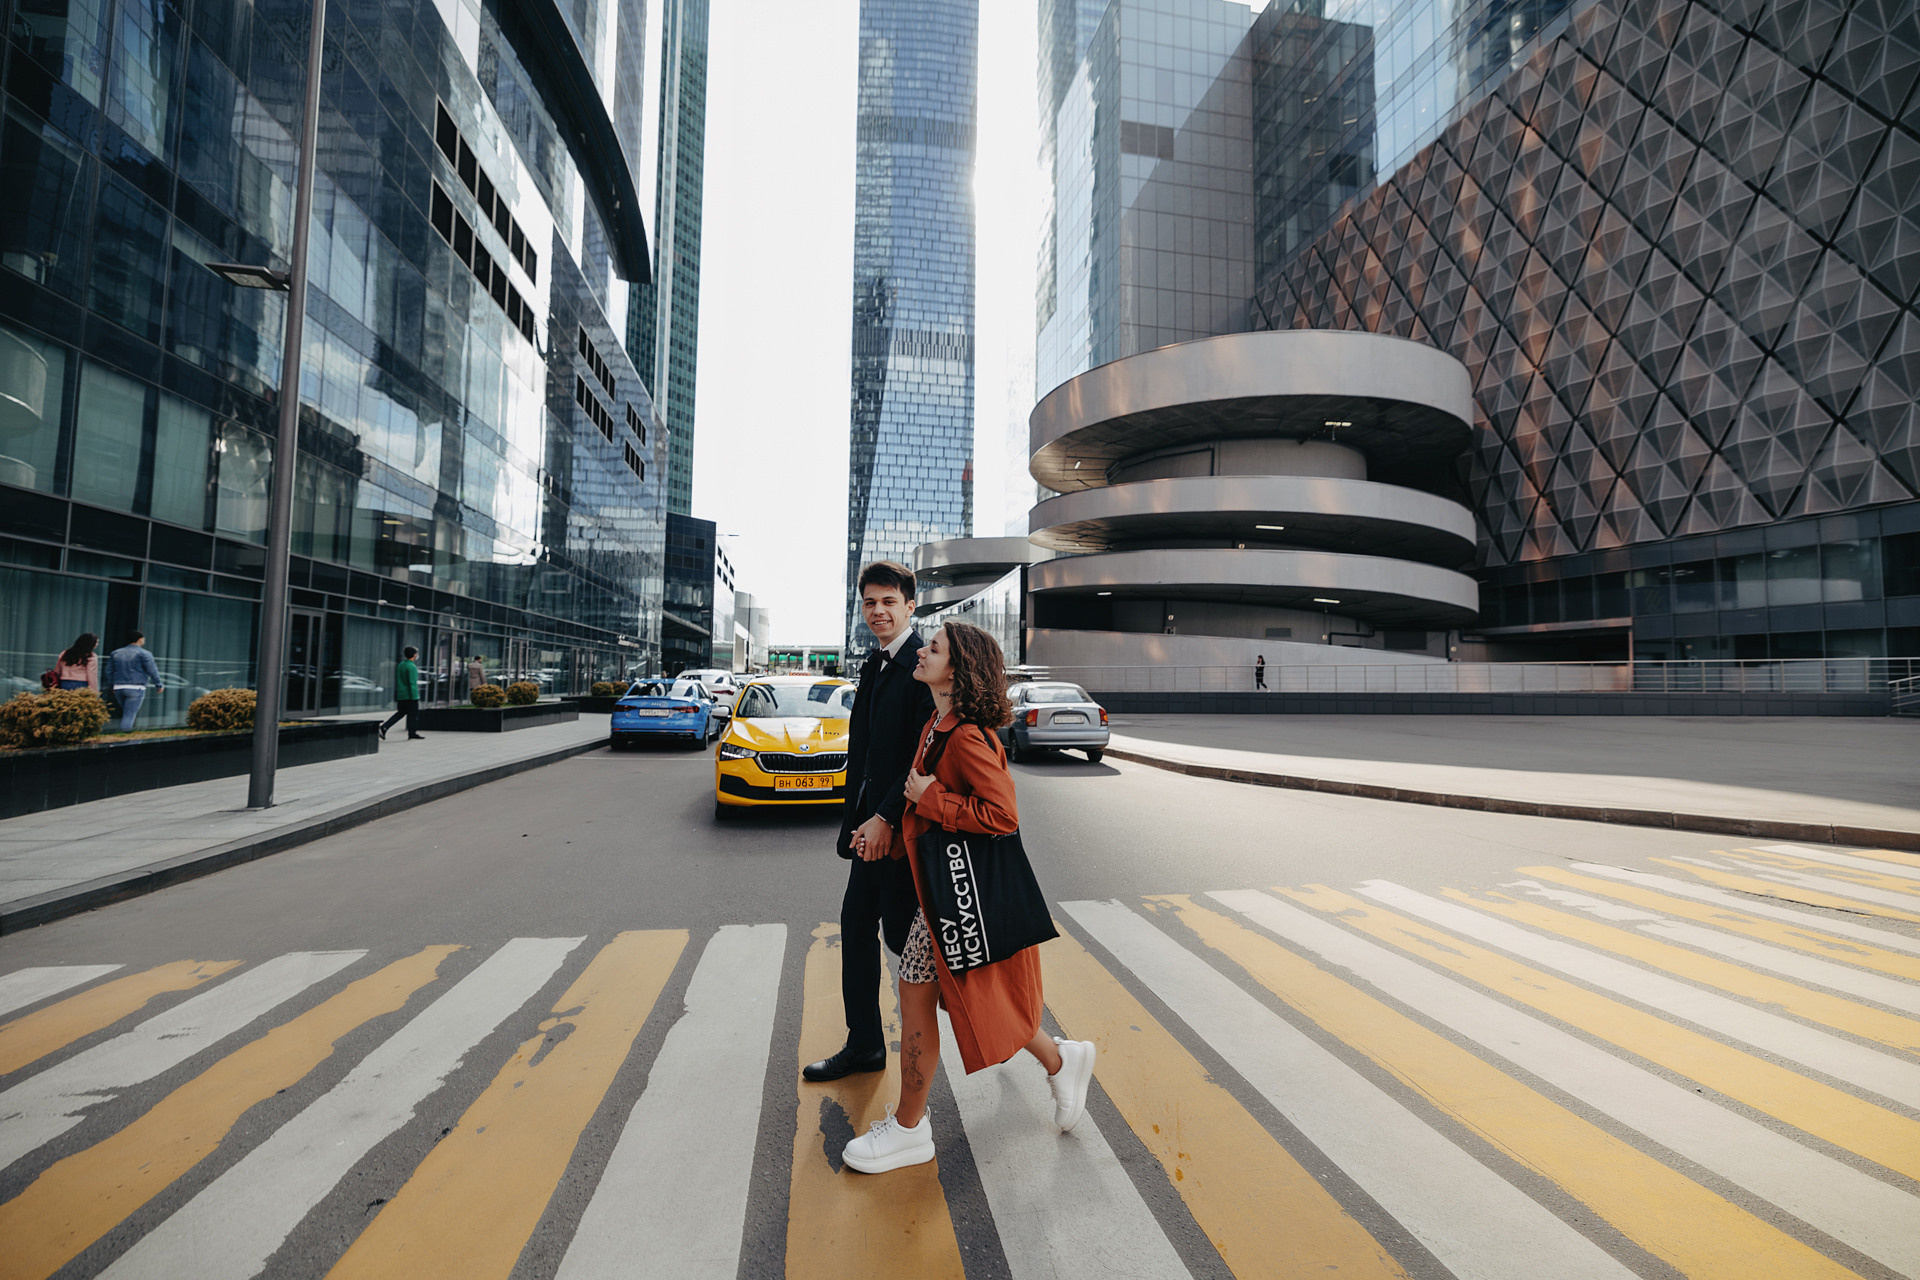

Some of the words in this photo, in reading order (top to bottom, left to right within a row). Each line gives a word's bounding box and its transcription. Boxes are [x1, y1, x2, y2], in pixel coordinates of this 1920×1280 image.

[795, 778, 814, 787] 063
[946, 843, 983, 967] ИСКУССТВО
[940, 918, 963, 970] НЕСУ
